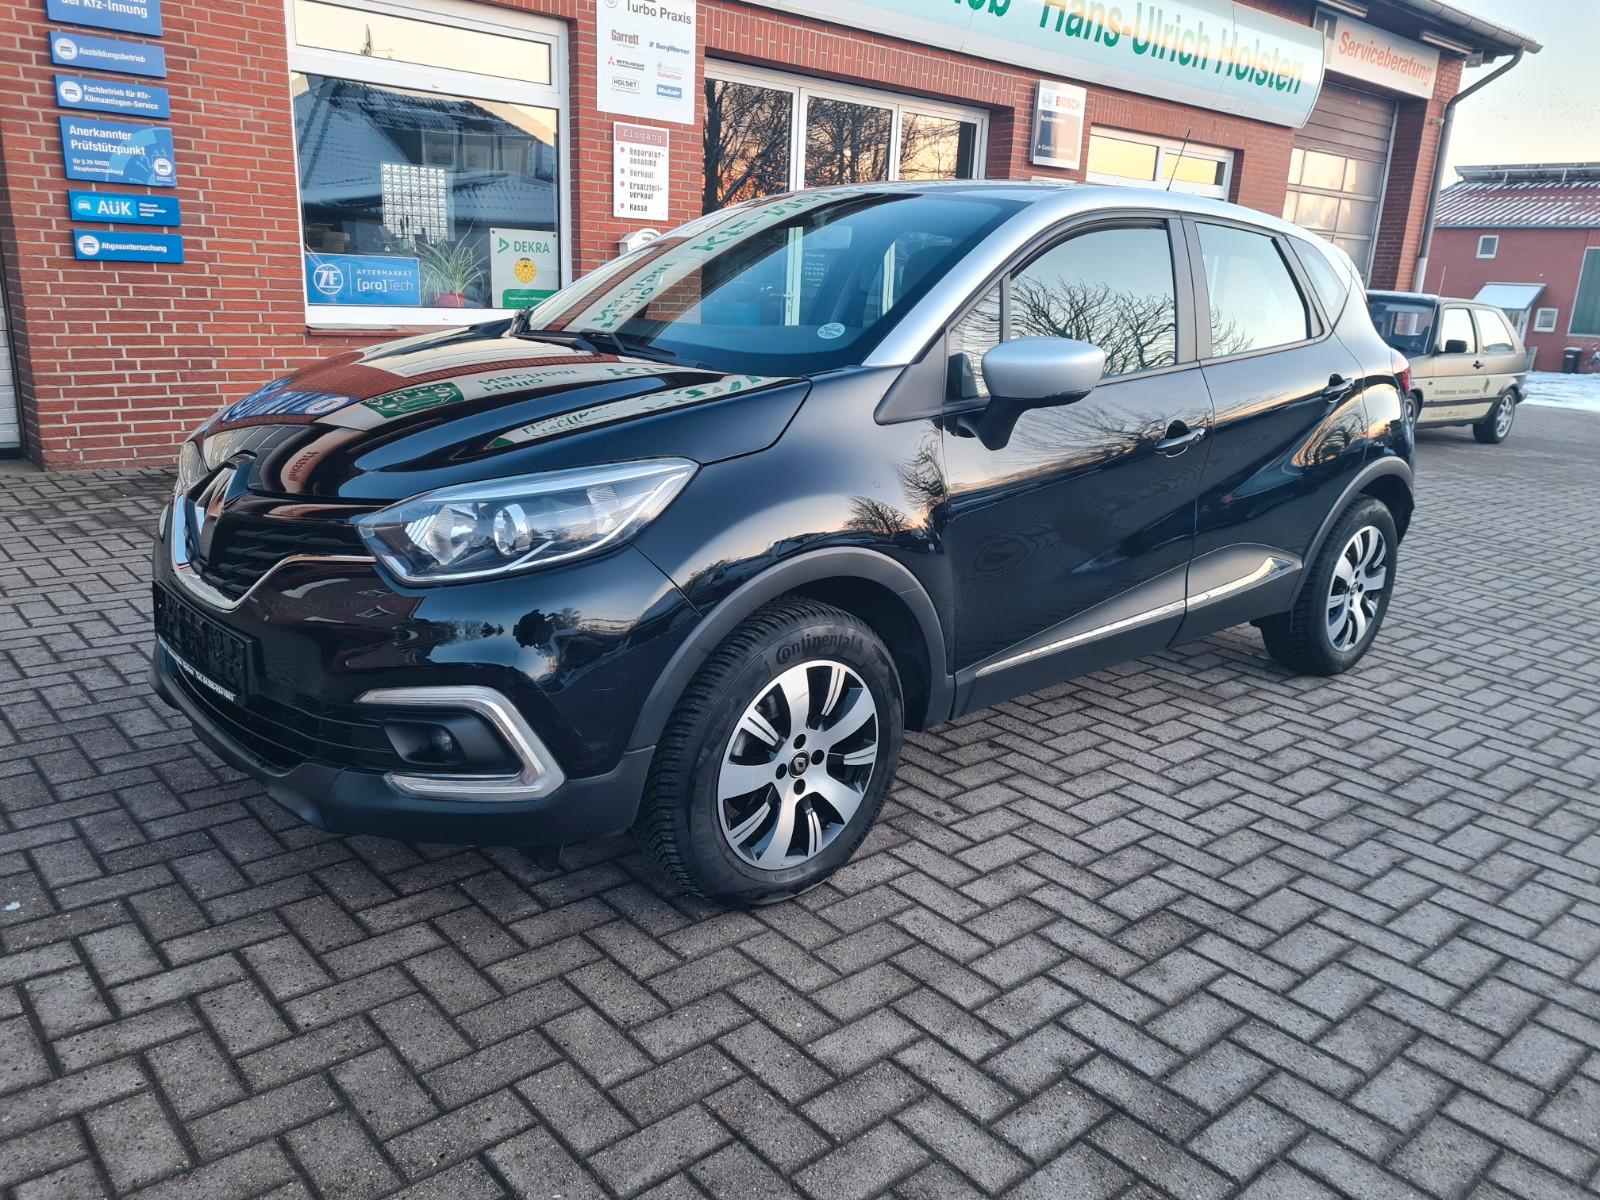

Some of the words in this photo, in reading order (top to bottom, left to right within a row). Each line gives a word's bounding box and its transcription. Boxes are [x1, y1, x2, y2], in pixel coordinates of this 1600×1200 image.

[627, 0, 657, 16] Turbo
[659, 7, 692, 24] Praxis
[611, 29, 639, 45] Garrett
[79, 47, 146, 63] Ausbildungsbetrieb
[1039, 0, 1211, 70] Hans-Ulrich
[1214, 28, 1304, 94] Holsten
[1339, 31, 1433, 86] Serviceberatung
[83, 84, 125, 97] Fachbetrieb
[613, 79, 637, 88] HOLSET
[69, 125, 133, 141] Anerkannter
[622, 128, 662, 144] Eingang
[70, 139, 146, 157] Prüfstützpunkt
[629, 203, 648, 212] Kasse
[101, 241, 167, 254] Abgasuntersuchung
[513, 240, 551, 254] DEKRA
[356, 268, 412, 277] AFTERMARKET
[775, 633, 856, 665] Continental
